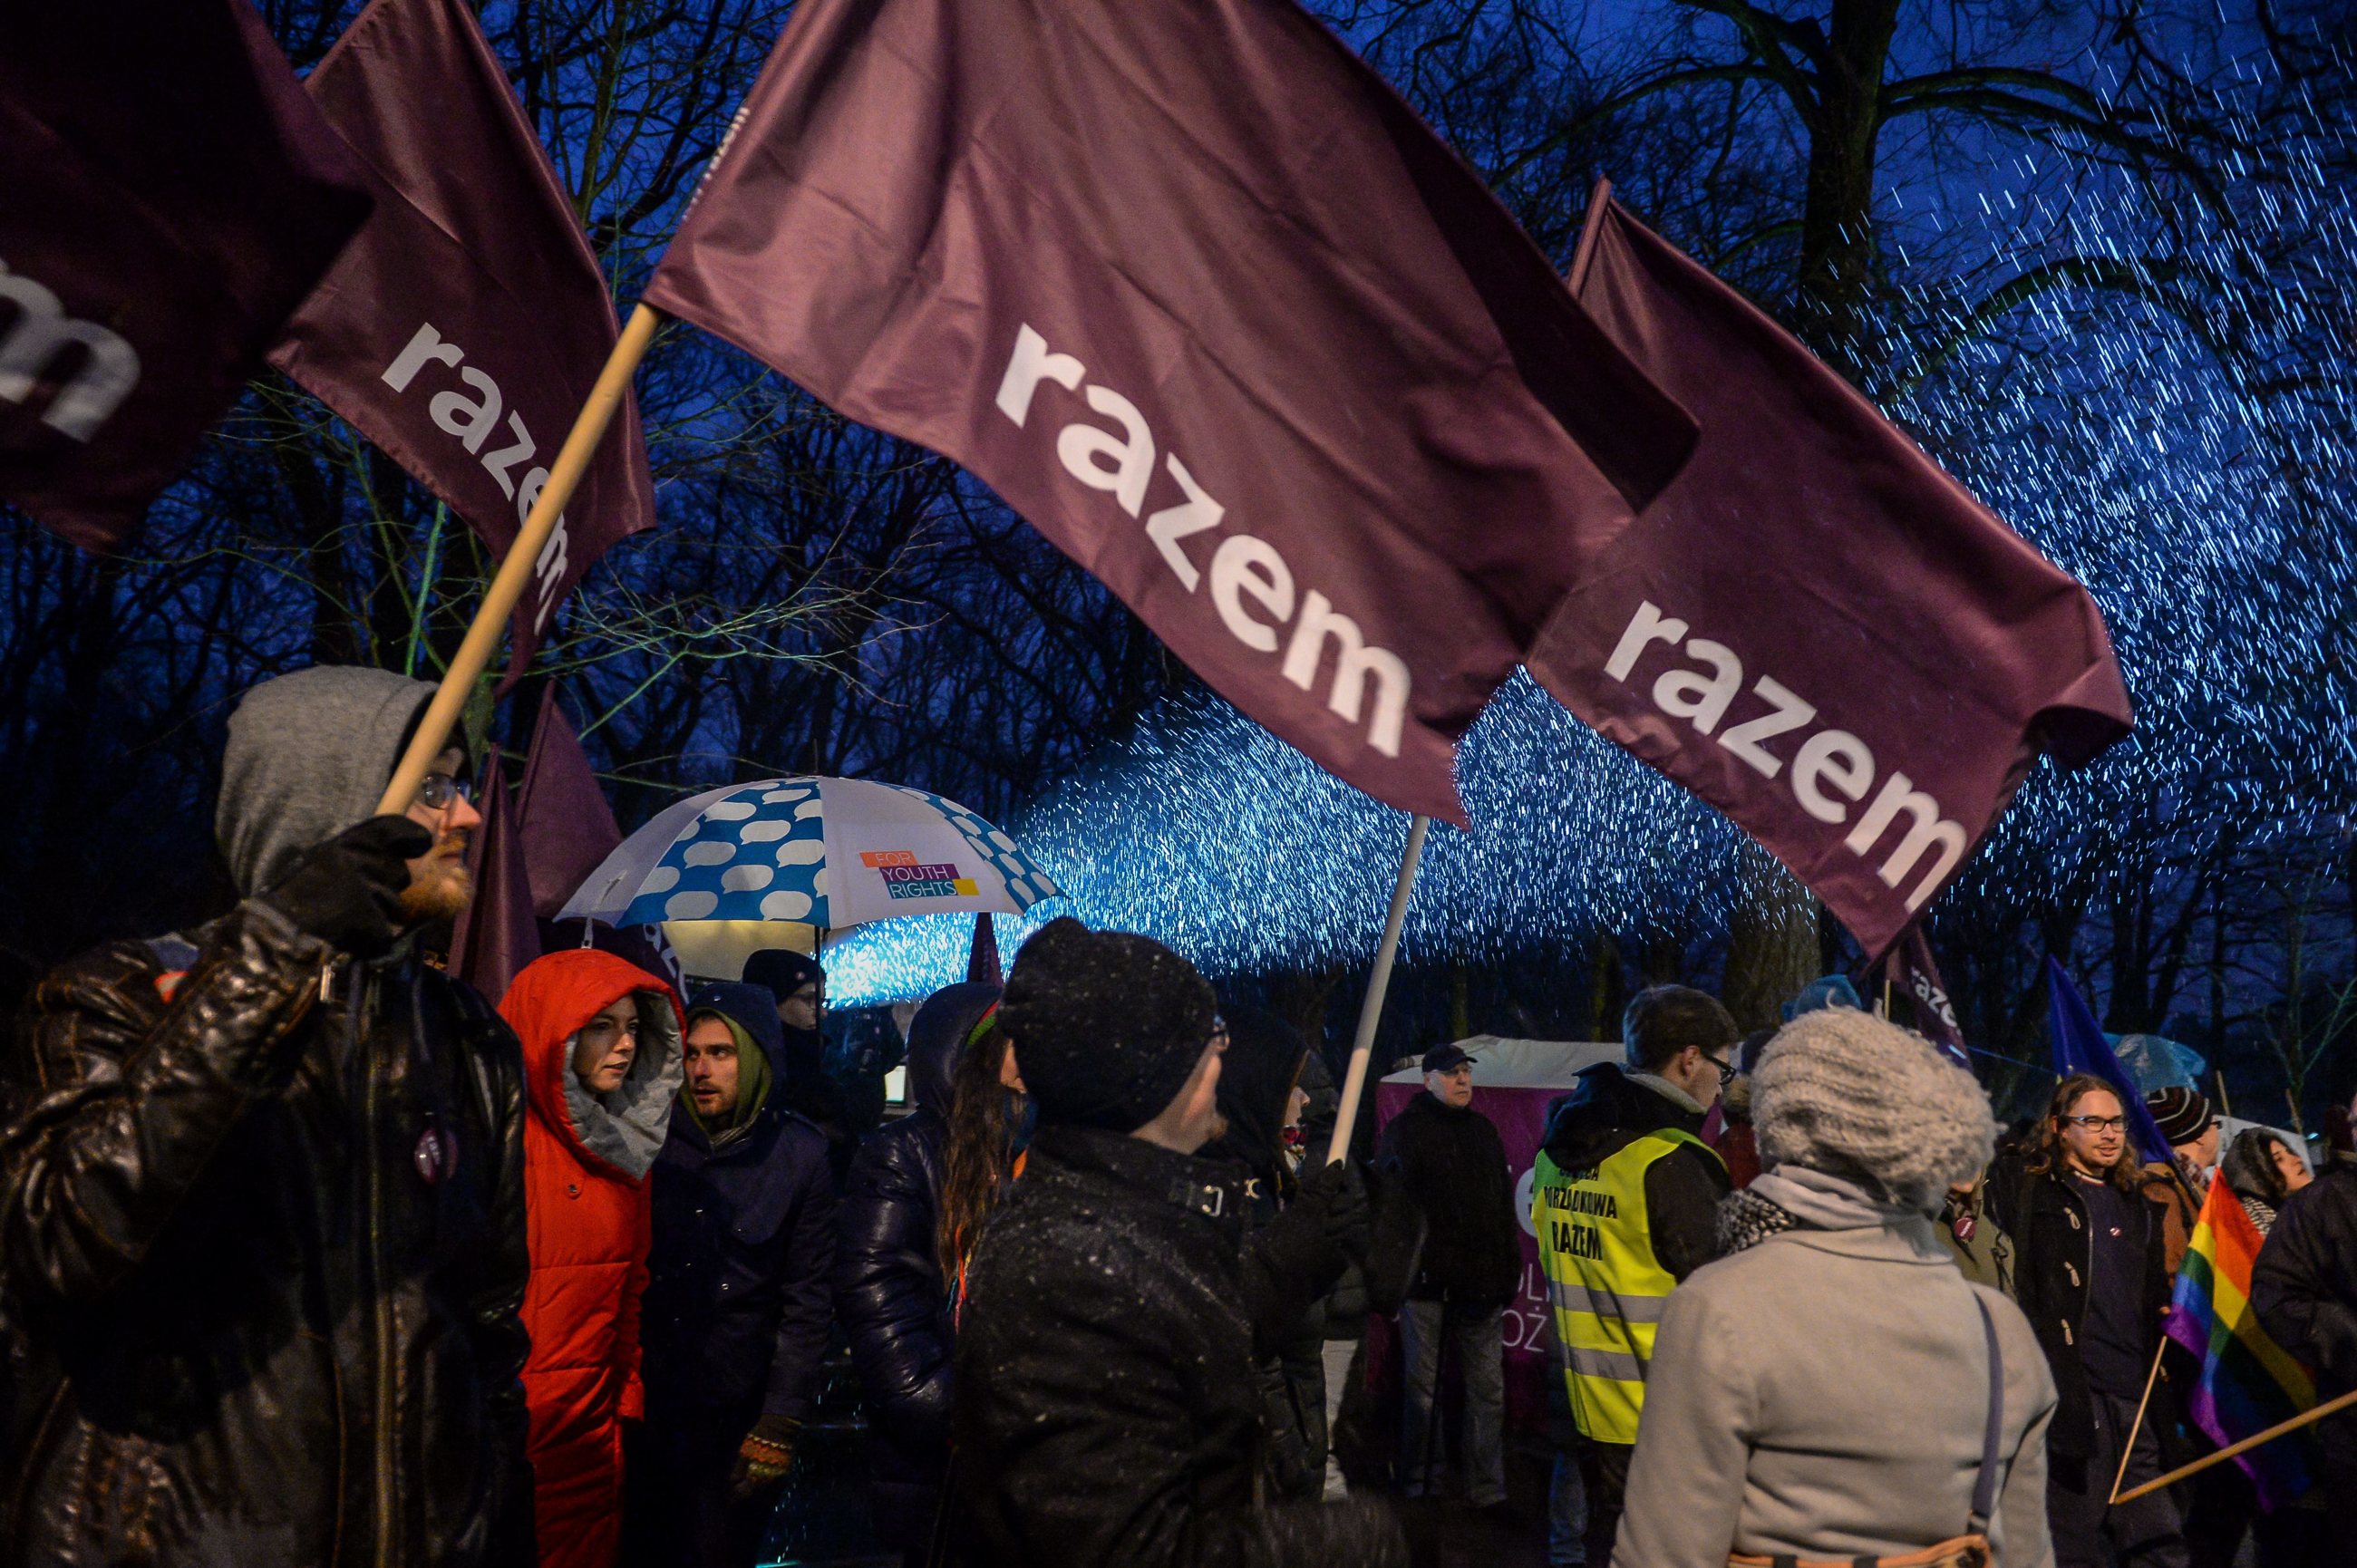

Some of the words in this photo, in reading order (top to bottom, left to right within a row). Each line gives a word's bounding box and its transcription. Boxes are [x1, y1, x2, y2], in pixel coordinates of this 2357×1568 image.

[995, 322, 1411, 759] razem
[1603, 600, 1967, 914] razem
[875, 852, 911, 866] FOR
[881, 866, 950, 882] YOUTH
[888, 880, 957, 899] RIGHTS
